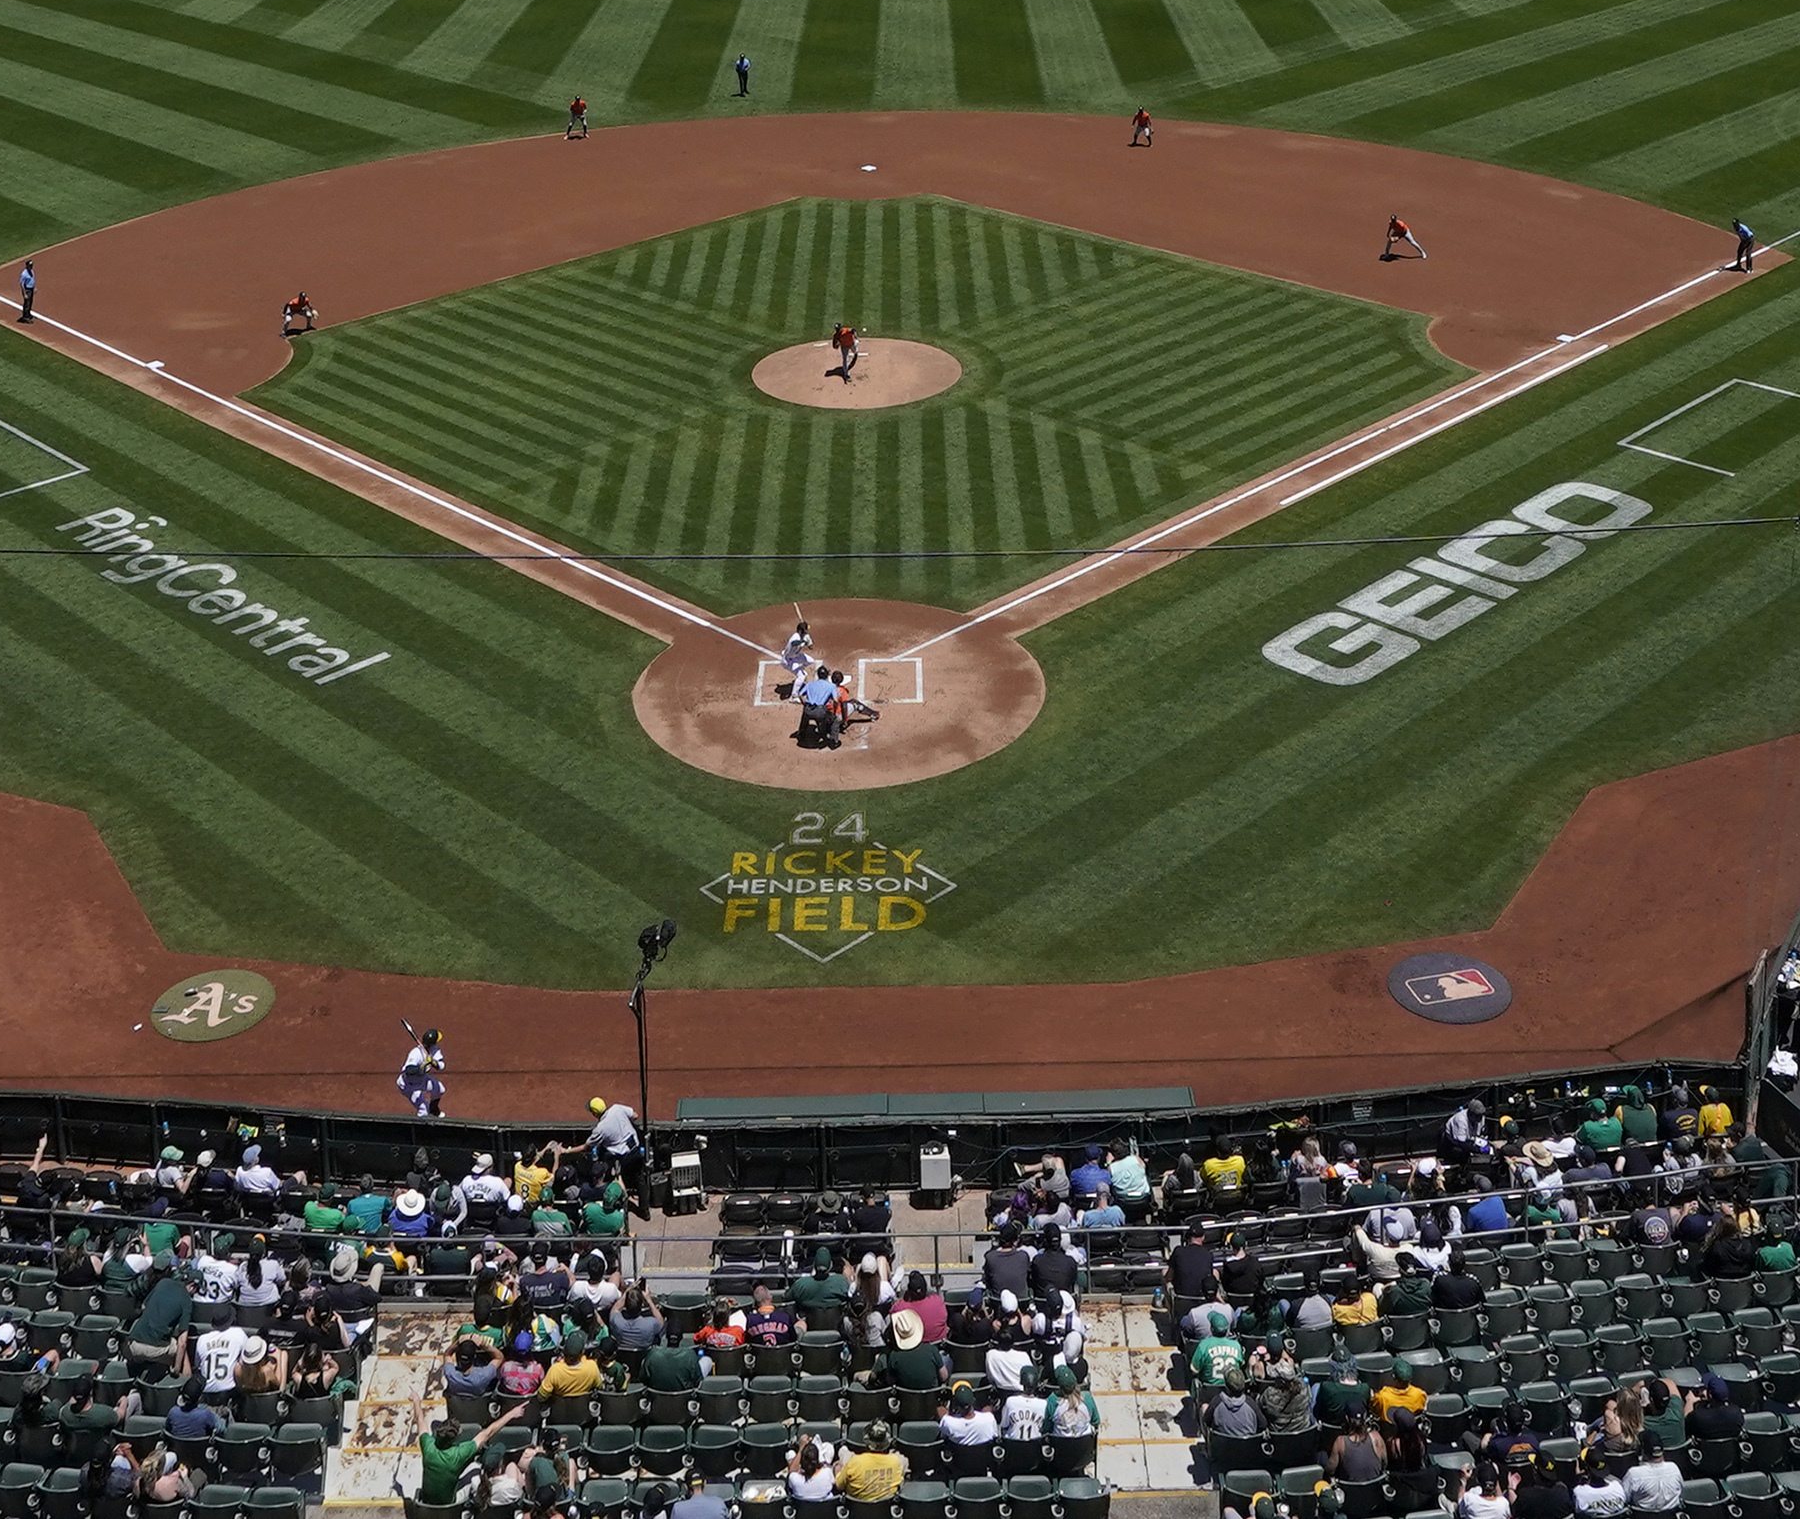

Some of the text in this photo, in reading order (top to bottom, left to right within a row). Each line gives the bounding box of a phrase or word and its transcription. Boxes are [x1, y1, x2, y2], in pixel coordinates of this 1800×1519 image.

[55, 506, 391, 685] RingCentral
[1261, 481, 1654, 685] GEICO
[790, 810, 868, 845] 24
[731, 849, 923, 875] RICKEY
[727, 877, 928, 895] HENDERSON
[723, 896, 927, 932] FIELD
[160, 982, 258, 1029] A's
[204, 1353, 229, 1380] 15
